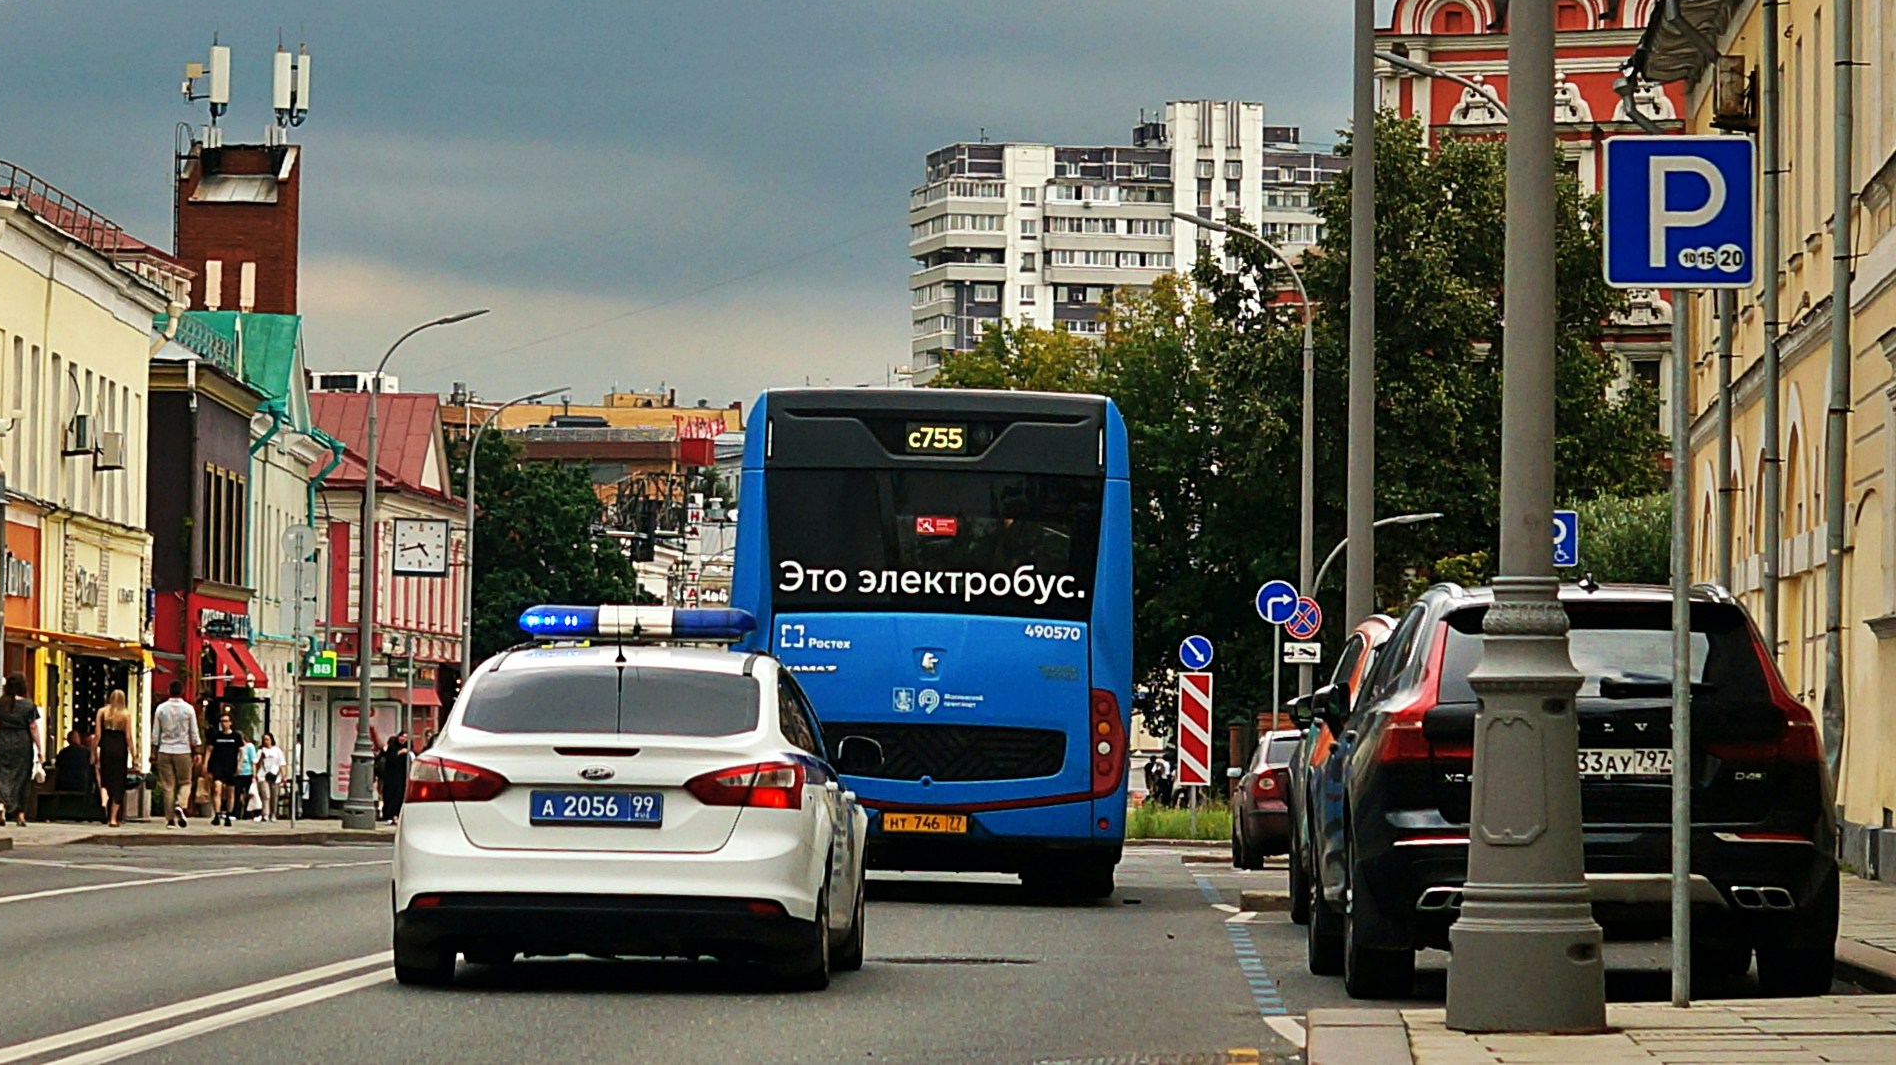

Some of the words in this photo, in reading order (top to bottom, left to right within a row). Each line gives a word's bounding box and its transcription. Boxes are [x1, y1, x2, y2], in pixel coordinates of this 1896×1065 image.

[1649, 155, 1727, 268] P
[1682, 252, 1696, 264] 10
[1698, 251, 1716, 265] 15
[1719, 249, 1744, 267] 20
[779, 560, 847, 592] Это
[857, 565, 1086, 605] электробус.
[1024, 624, 1081, 641] 490570
[808, 637, 851, 649] Ростех
[1578, 751, 1632, 772] 33АУ
[1635, 750, 1668, 767] 797
[563, 796, 619, 817] 2056
[632, 796, 654, 812] 99
[914, 816, 940, 830] 746
